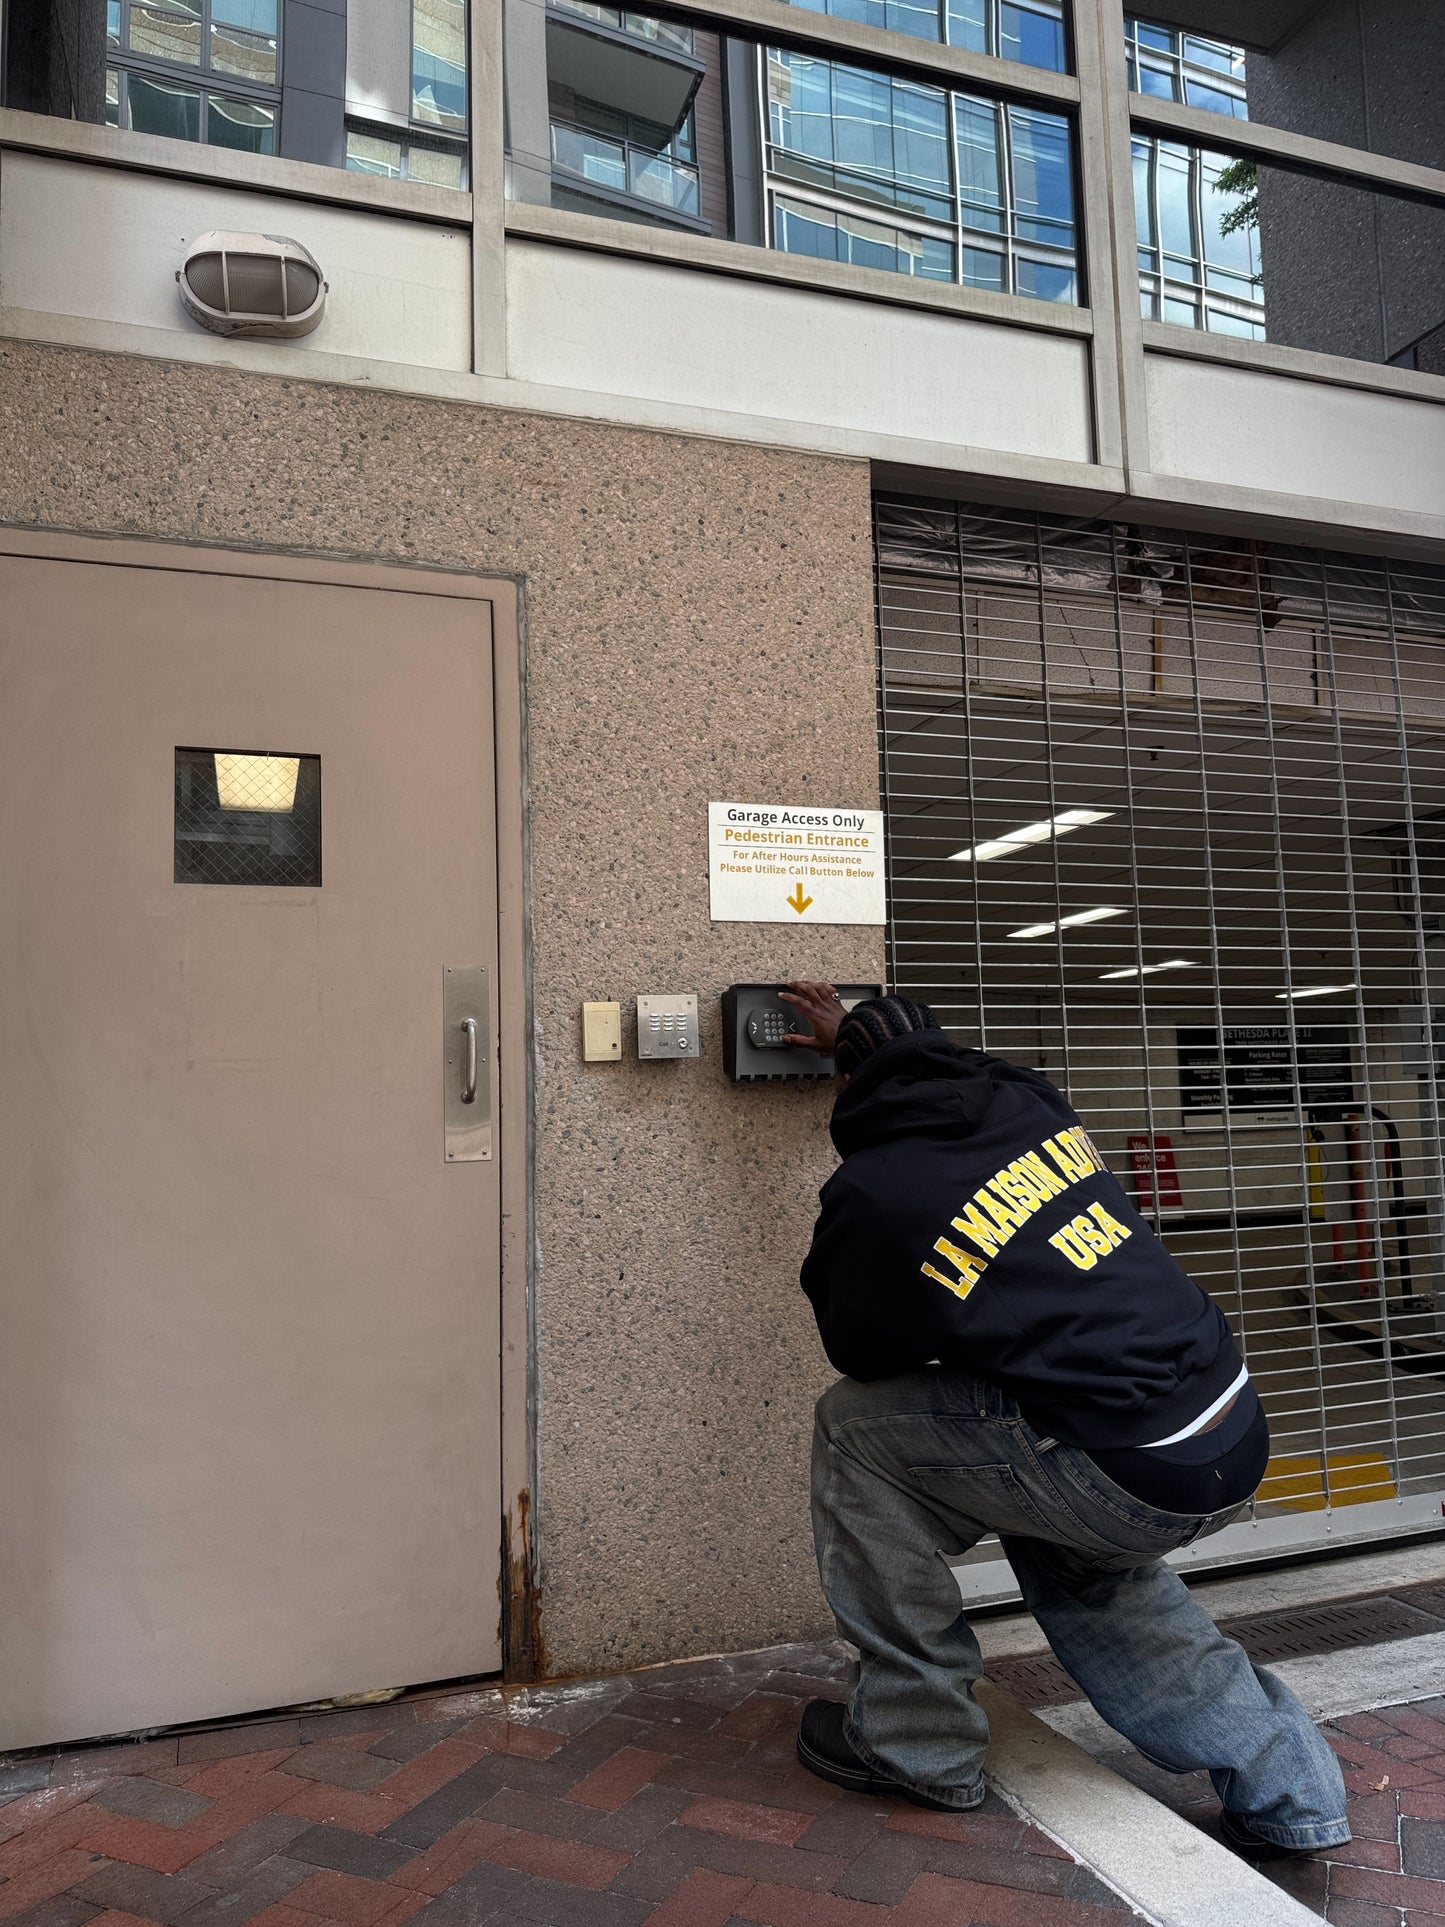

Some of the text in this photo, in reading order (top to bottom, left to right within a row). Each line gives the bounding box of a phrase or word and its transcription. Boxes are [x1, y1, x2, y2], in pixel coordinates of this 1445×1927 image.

[727, 808, 865, 831] Garage Access Only
[724, 828, 869, 848] Pedestrian Entrance
[733, 850, 862, 865] For After Hours Assistance
[720, 863, 875, 878] Please Utilize Call Button Below
[1222, 1028, 1270, 1039] BETHESDA
[1272, 1028, 1301, 1038] PLAE
[1131, 1141, 1147, 1151] We
[950, 1150, 1070, 1259] MAISON
[1047, 1201, 1133, 1271] USA
[920, 1235, 989, 1301] LA
